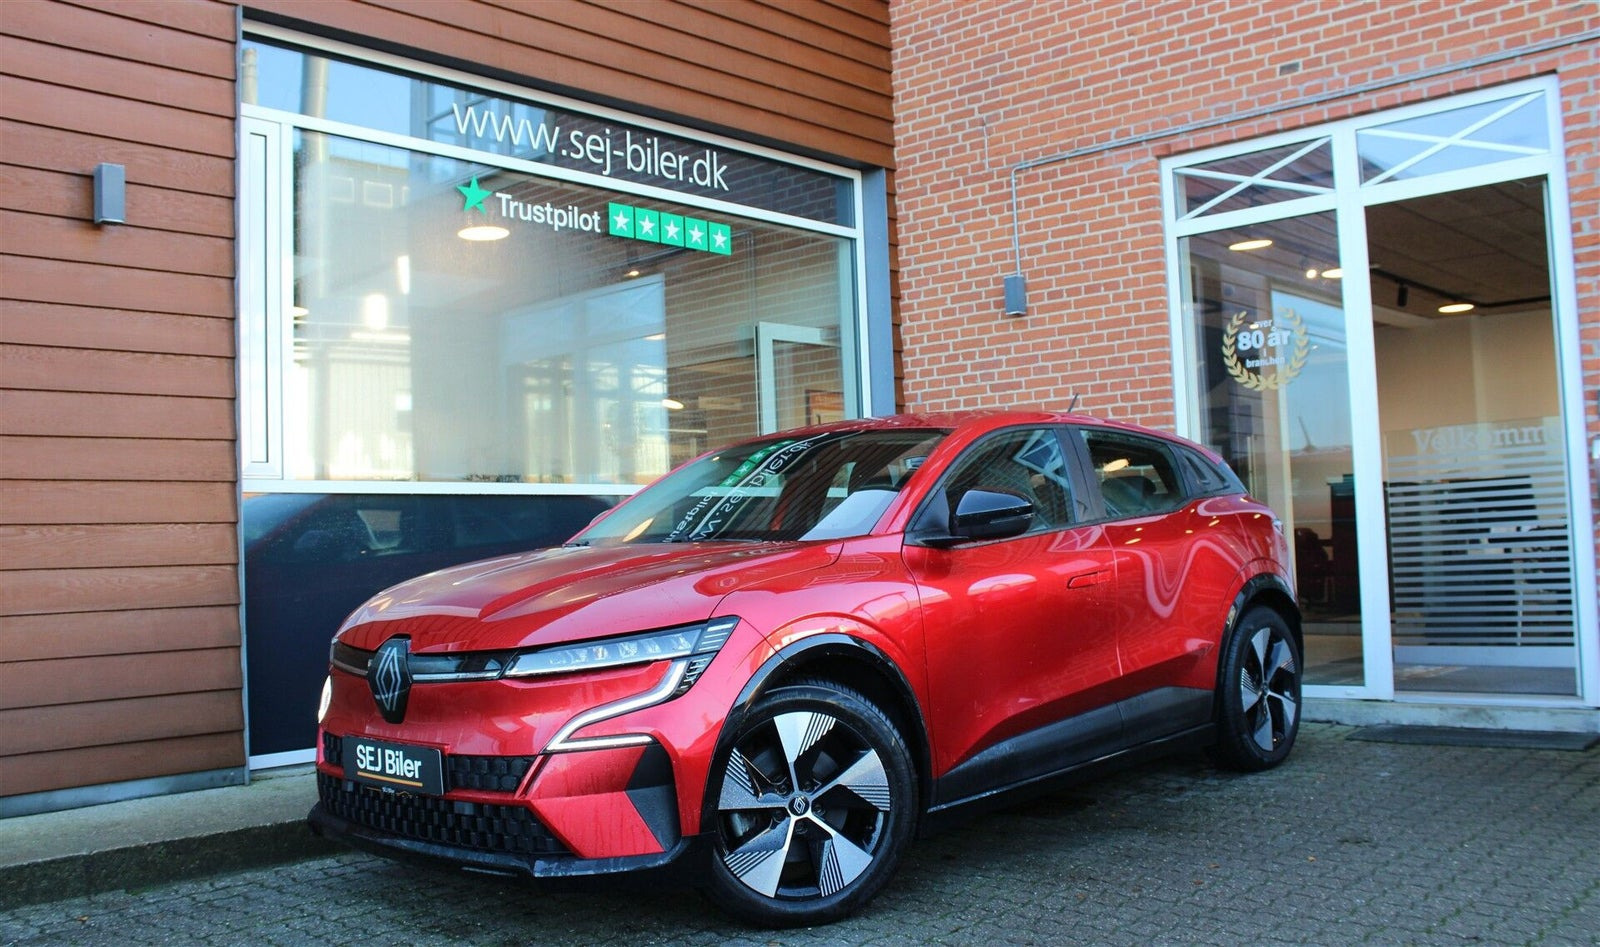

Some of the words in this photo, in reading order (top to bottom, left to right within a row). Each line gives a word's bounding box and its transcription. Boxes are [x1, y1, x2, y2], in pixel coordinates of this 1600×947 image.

[453, 102, 730, 191] www.sej-biler.dk
[496, 192, 602, 233] Trustpilot
[1237, 330, 1264, 350] 80
[1267, 326, 1290, 346] år
[1412, 424, 1562, 450] Velkomm
[356, 744, 381, 771] SEJ
[385, 749, 422, 778] Biler
